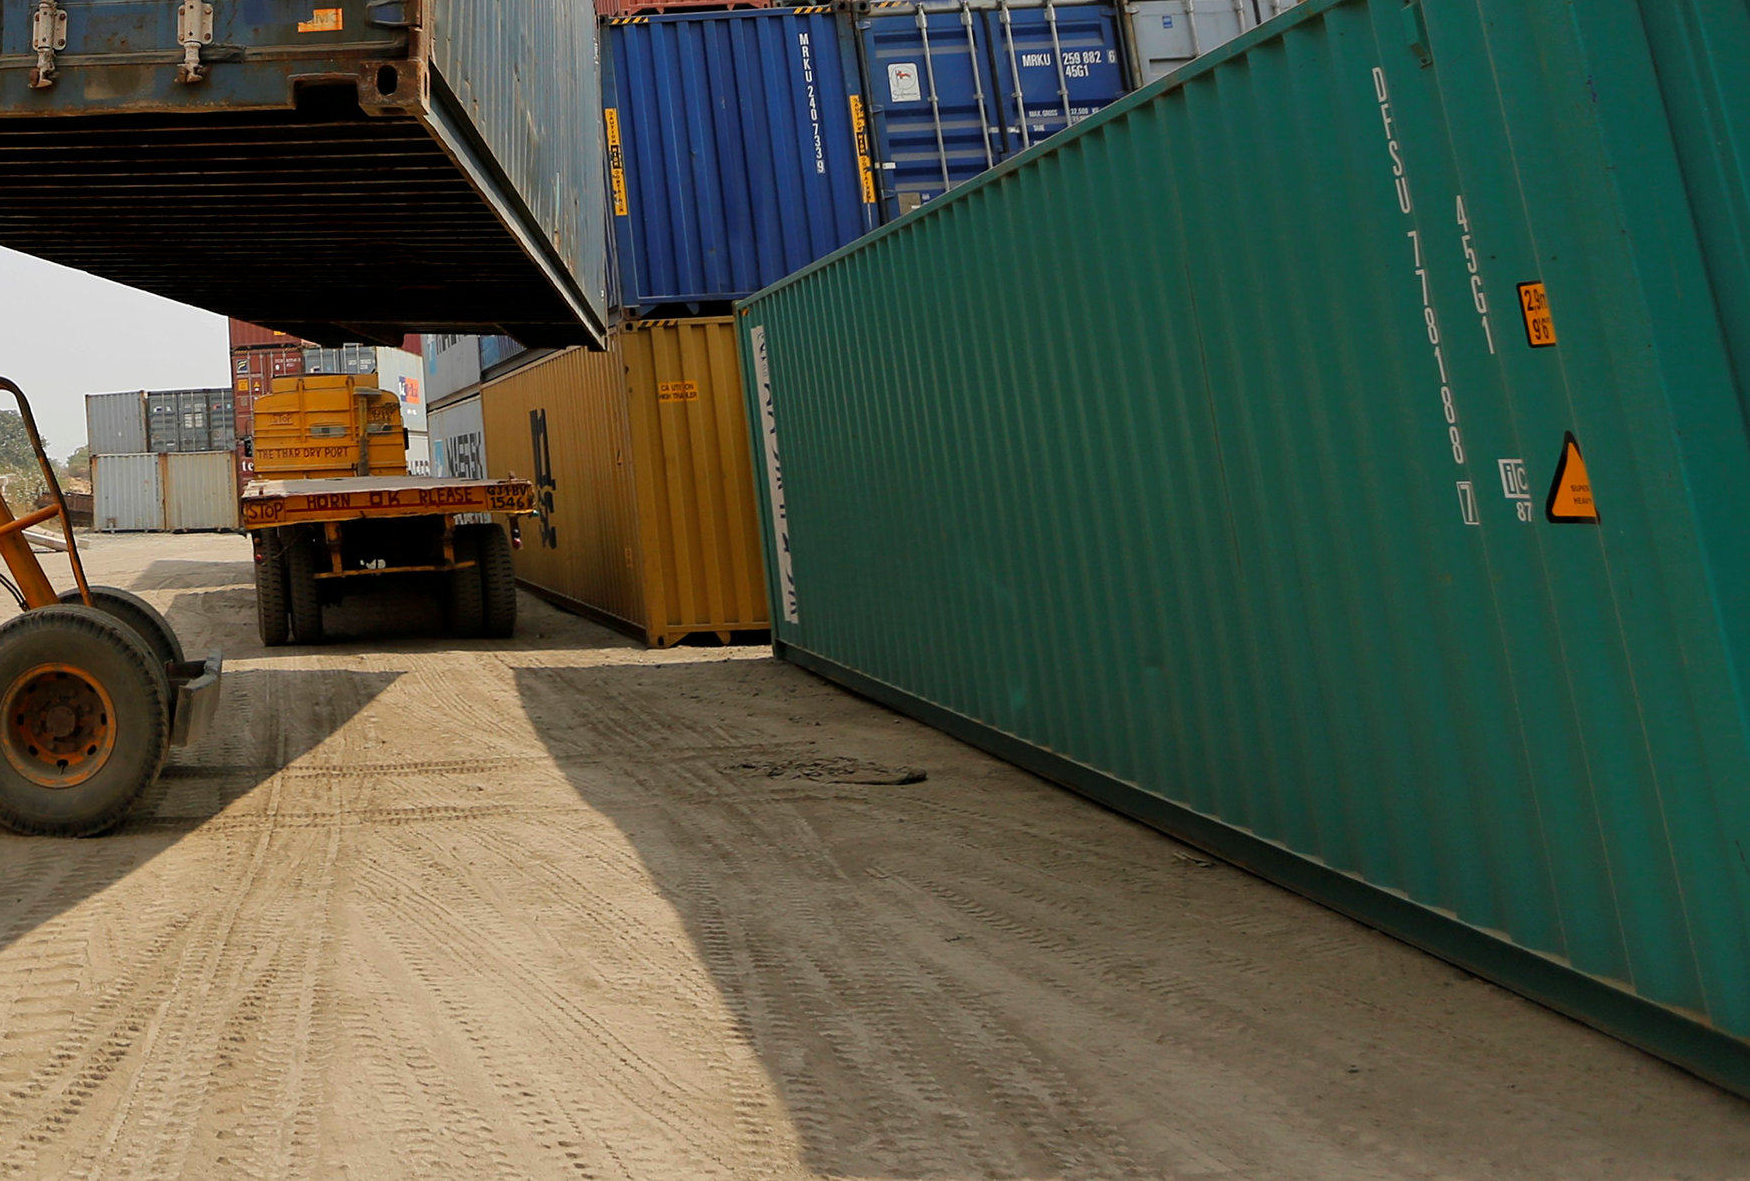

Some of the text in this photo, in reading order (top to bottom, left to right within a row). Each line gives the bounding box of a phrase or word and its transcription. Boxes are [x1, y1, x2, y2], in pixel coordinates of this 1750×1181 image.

[799, 33, 813, 83] MRKU
[1022, 54, 1051, 67] MRKU
[1062, 52, 1081, 65] 259
[1065, 65, 1089, 78] 45G1
[1372, 66, 1411, 214] DFSU
[1455, 195, 1495, 354] 45G1
[257, 445, 349, 460] THE THAR DRY PORT
[249, 501, 283, 519] STOP
[306, 492, 350, 511] HORN
[369, 491, 401, 507] OK
[489, 495, 525, 510] 1546
